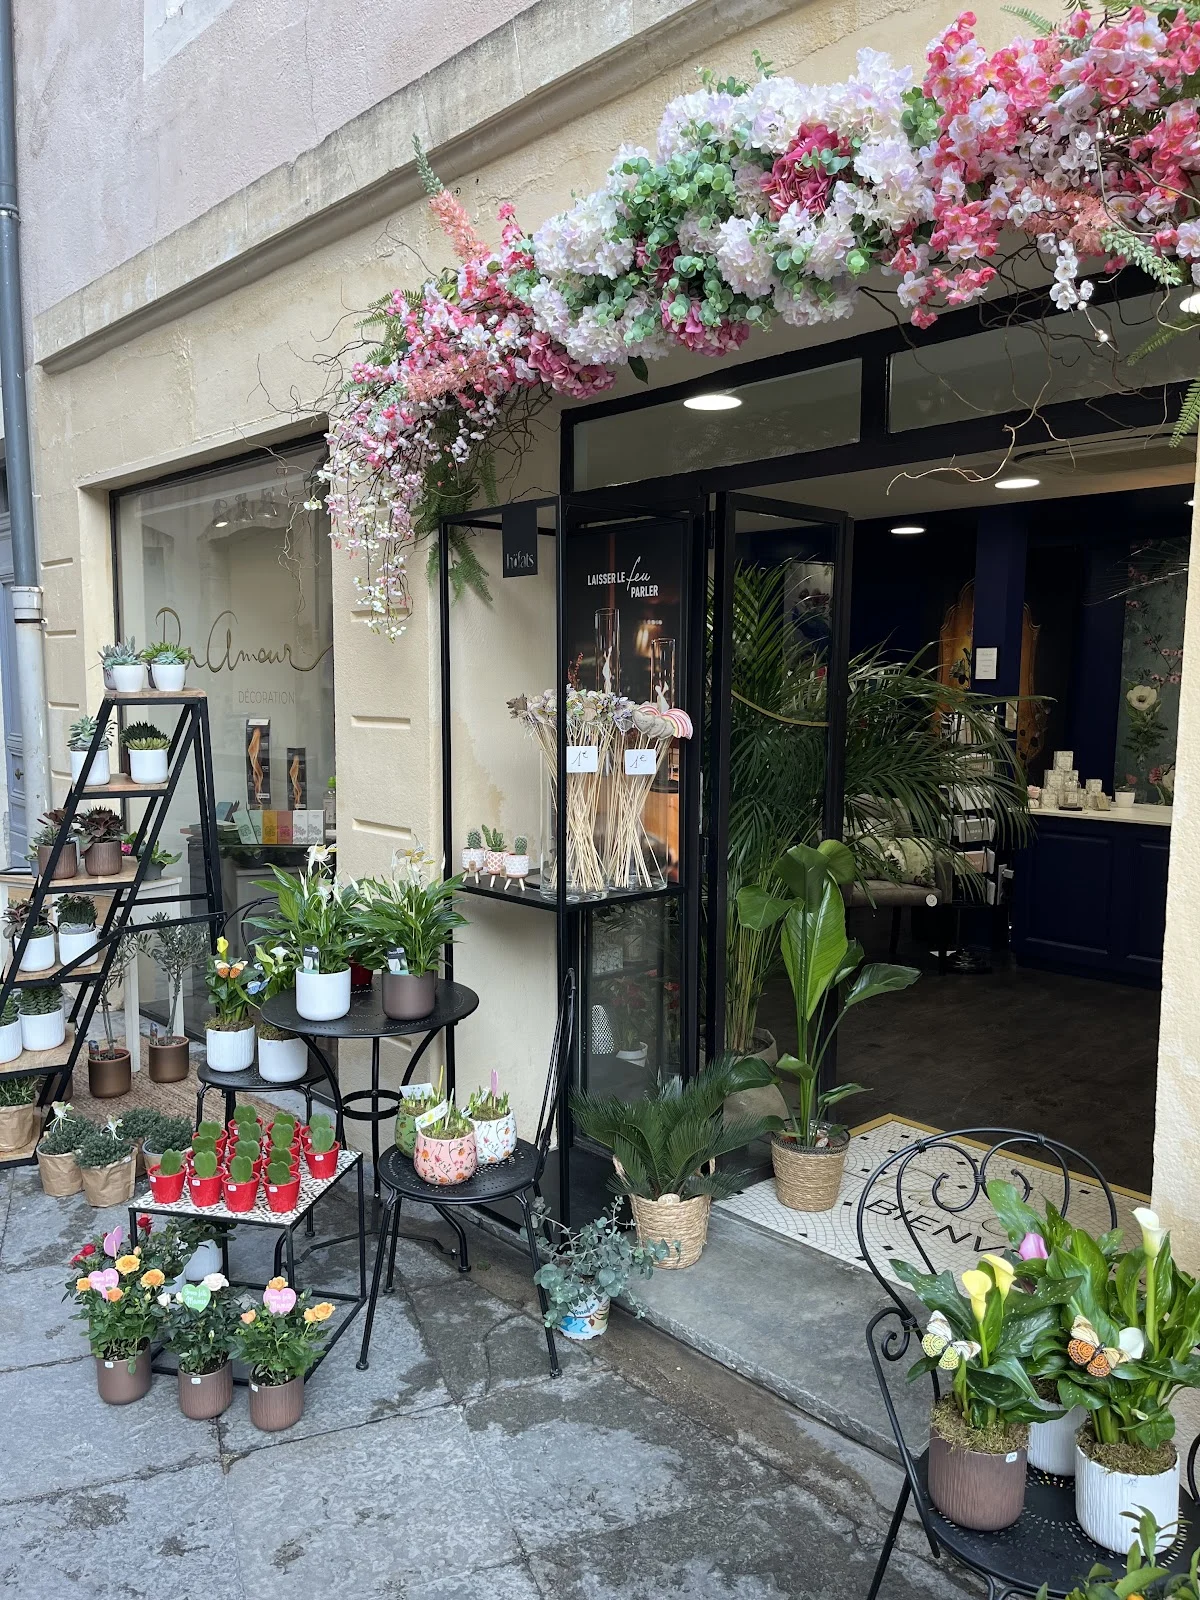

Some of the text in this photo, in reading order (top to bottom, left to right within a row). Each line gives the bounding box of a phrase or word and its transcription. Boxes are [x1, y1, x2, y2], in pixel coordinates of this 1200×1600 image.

[587, 555, 651, 591] LAISSER LE feu
[630, 584, 659, 598] PARLER
[207, 610, 333, 673] Amour
[238, 688, 295, 705] DÉCORATION
